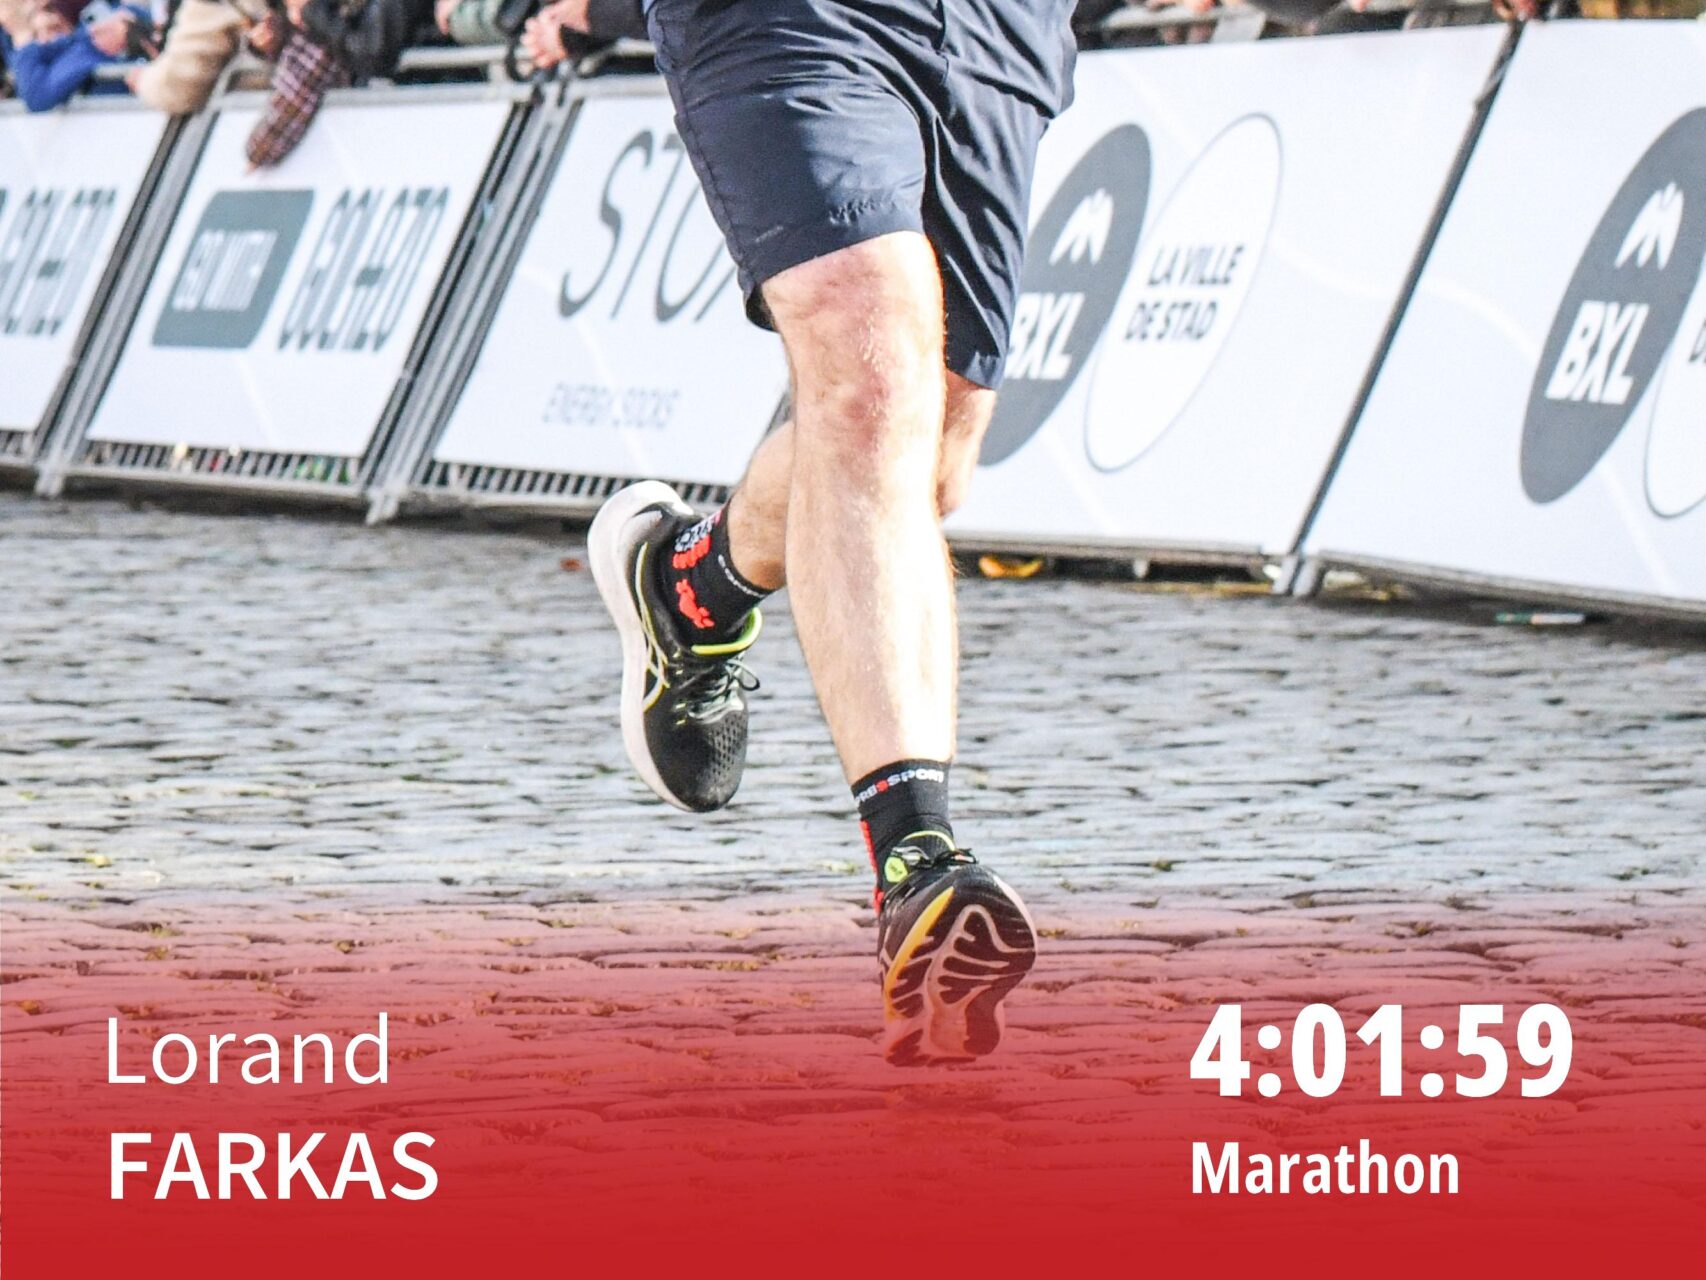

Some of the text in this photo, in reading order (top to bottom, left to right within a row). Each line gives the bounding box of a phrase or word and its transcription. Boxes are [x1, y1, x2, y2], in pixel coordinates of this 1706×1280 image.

[1148, 243, 1244, 286] LA VILLE
[1003, 292, 1086, 380] BXL
[1123, 299, 1218, 342] DE STAD
[1545, 299, 1649, 405] BXL
